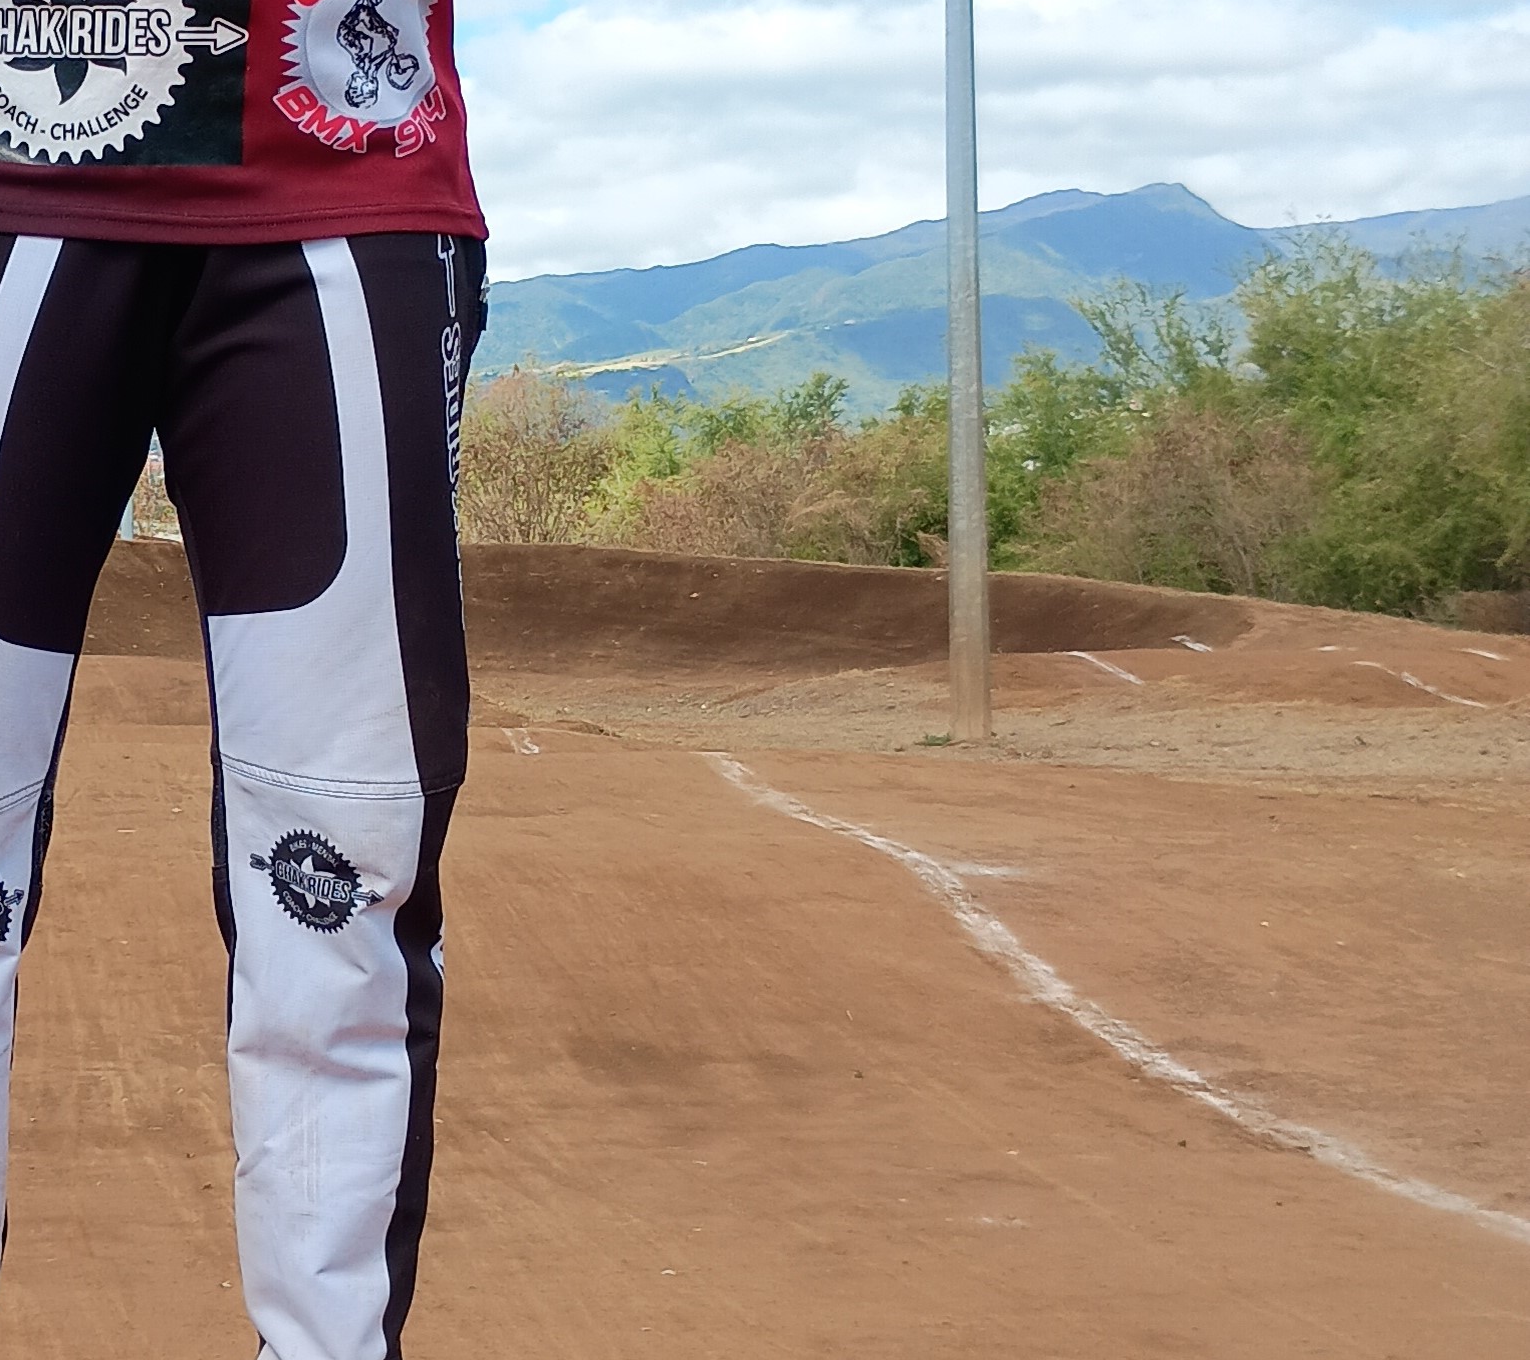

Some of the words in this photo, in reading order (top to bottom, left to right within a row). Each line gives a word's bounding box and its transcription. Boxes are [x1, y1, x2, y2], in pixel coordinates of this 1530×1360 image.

[69, 7, 172, 57] RIDES
[49, 82, 149, 142] CHALLENGE
[273, 85, 378, 154] BMX
[307, 875, 352, 904] RIDES
